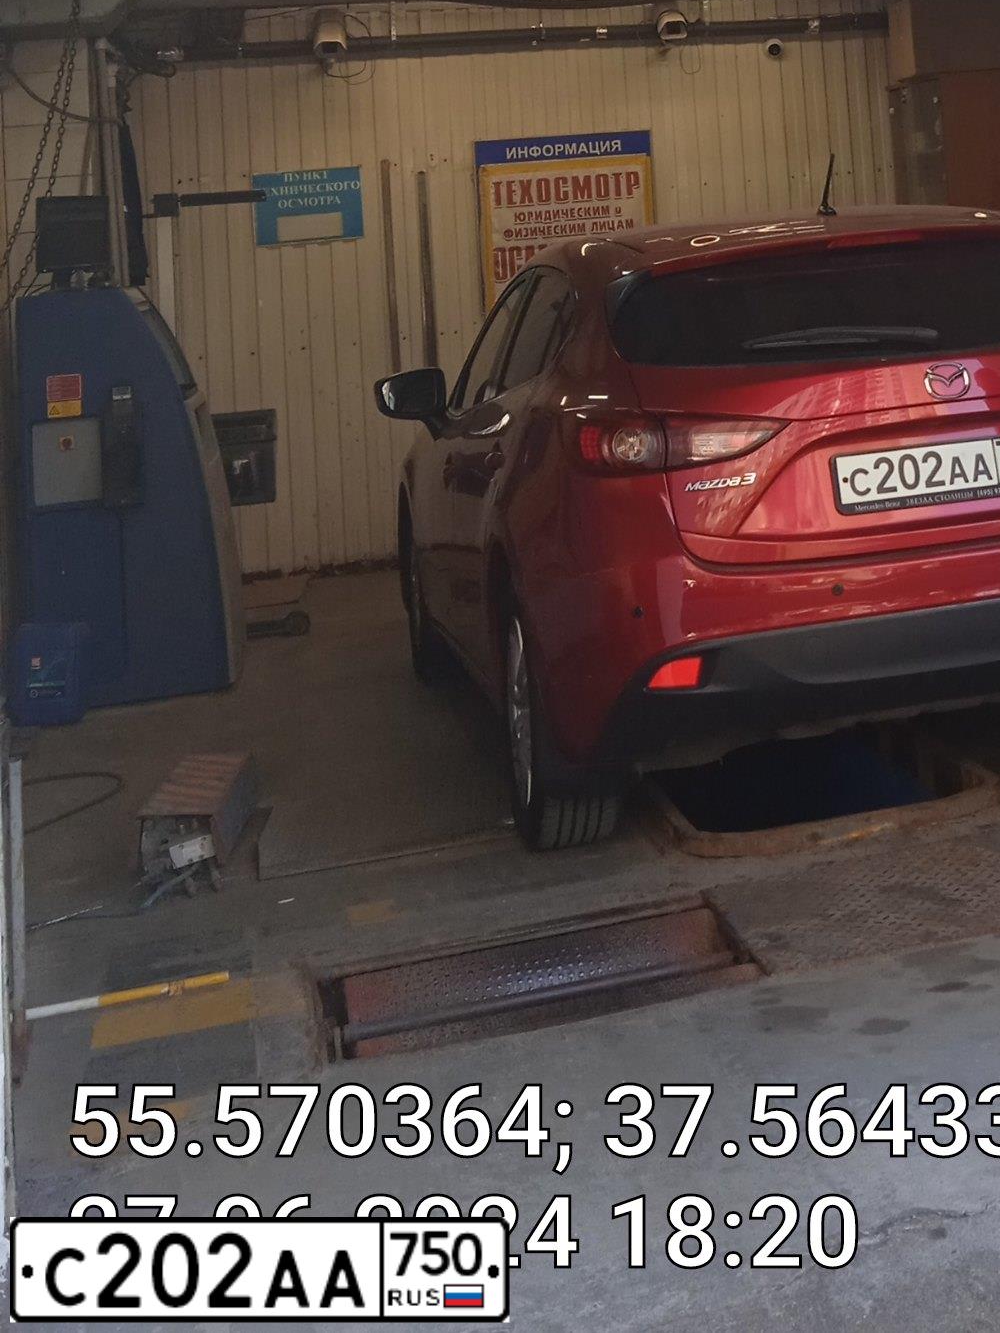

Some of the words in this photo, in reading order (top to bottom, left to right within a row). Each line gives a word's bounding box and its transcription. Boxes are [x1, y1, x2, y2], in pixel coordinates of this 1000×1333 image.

[506, 139, 622, 160] ИНФОРМАЦИЯ
[284, 170, 329, 183] ПУНКТ
[265, 180, 361, 198] ХНИЧЕСКОГО
[492, 170, 641, 208] ТЕХОСМОТР
[278, 195, 341, 209] ОСМОТРА
[513, 205, 611, 225] ЮРИДИЧЕСКИМ
[503, 222, 587, 241] ФИЗИЧЕСКИМ
[590, 218, 635, 234] ЛИЦАМ
[850, 450, 993, 497] С202АА
